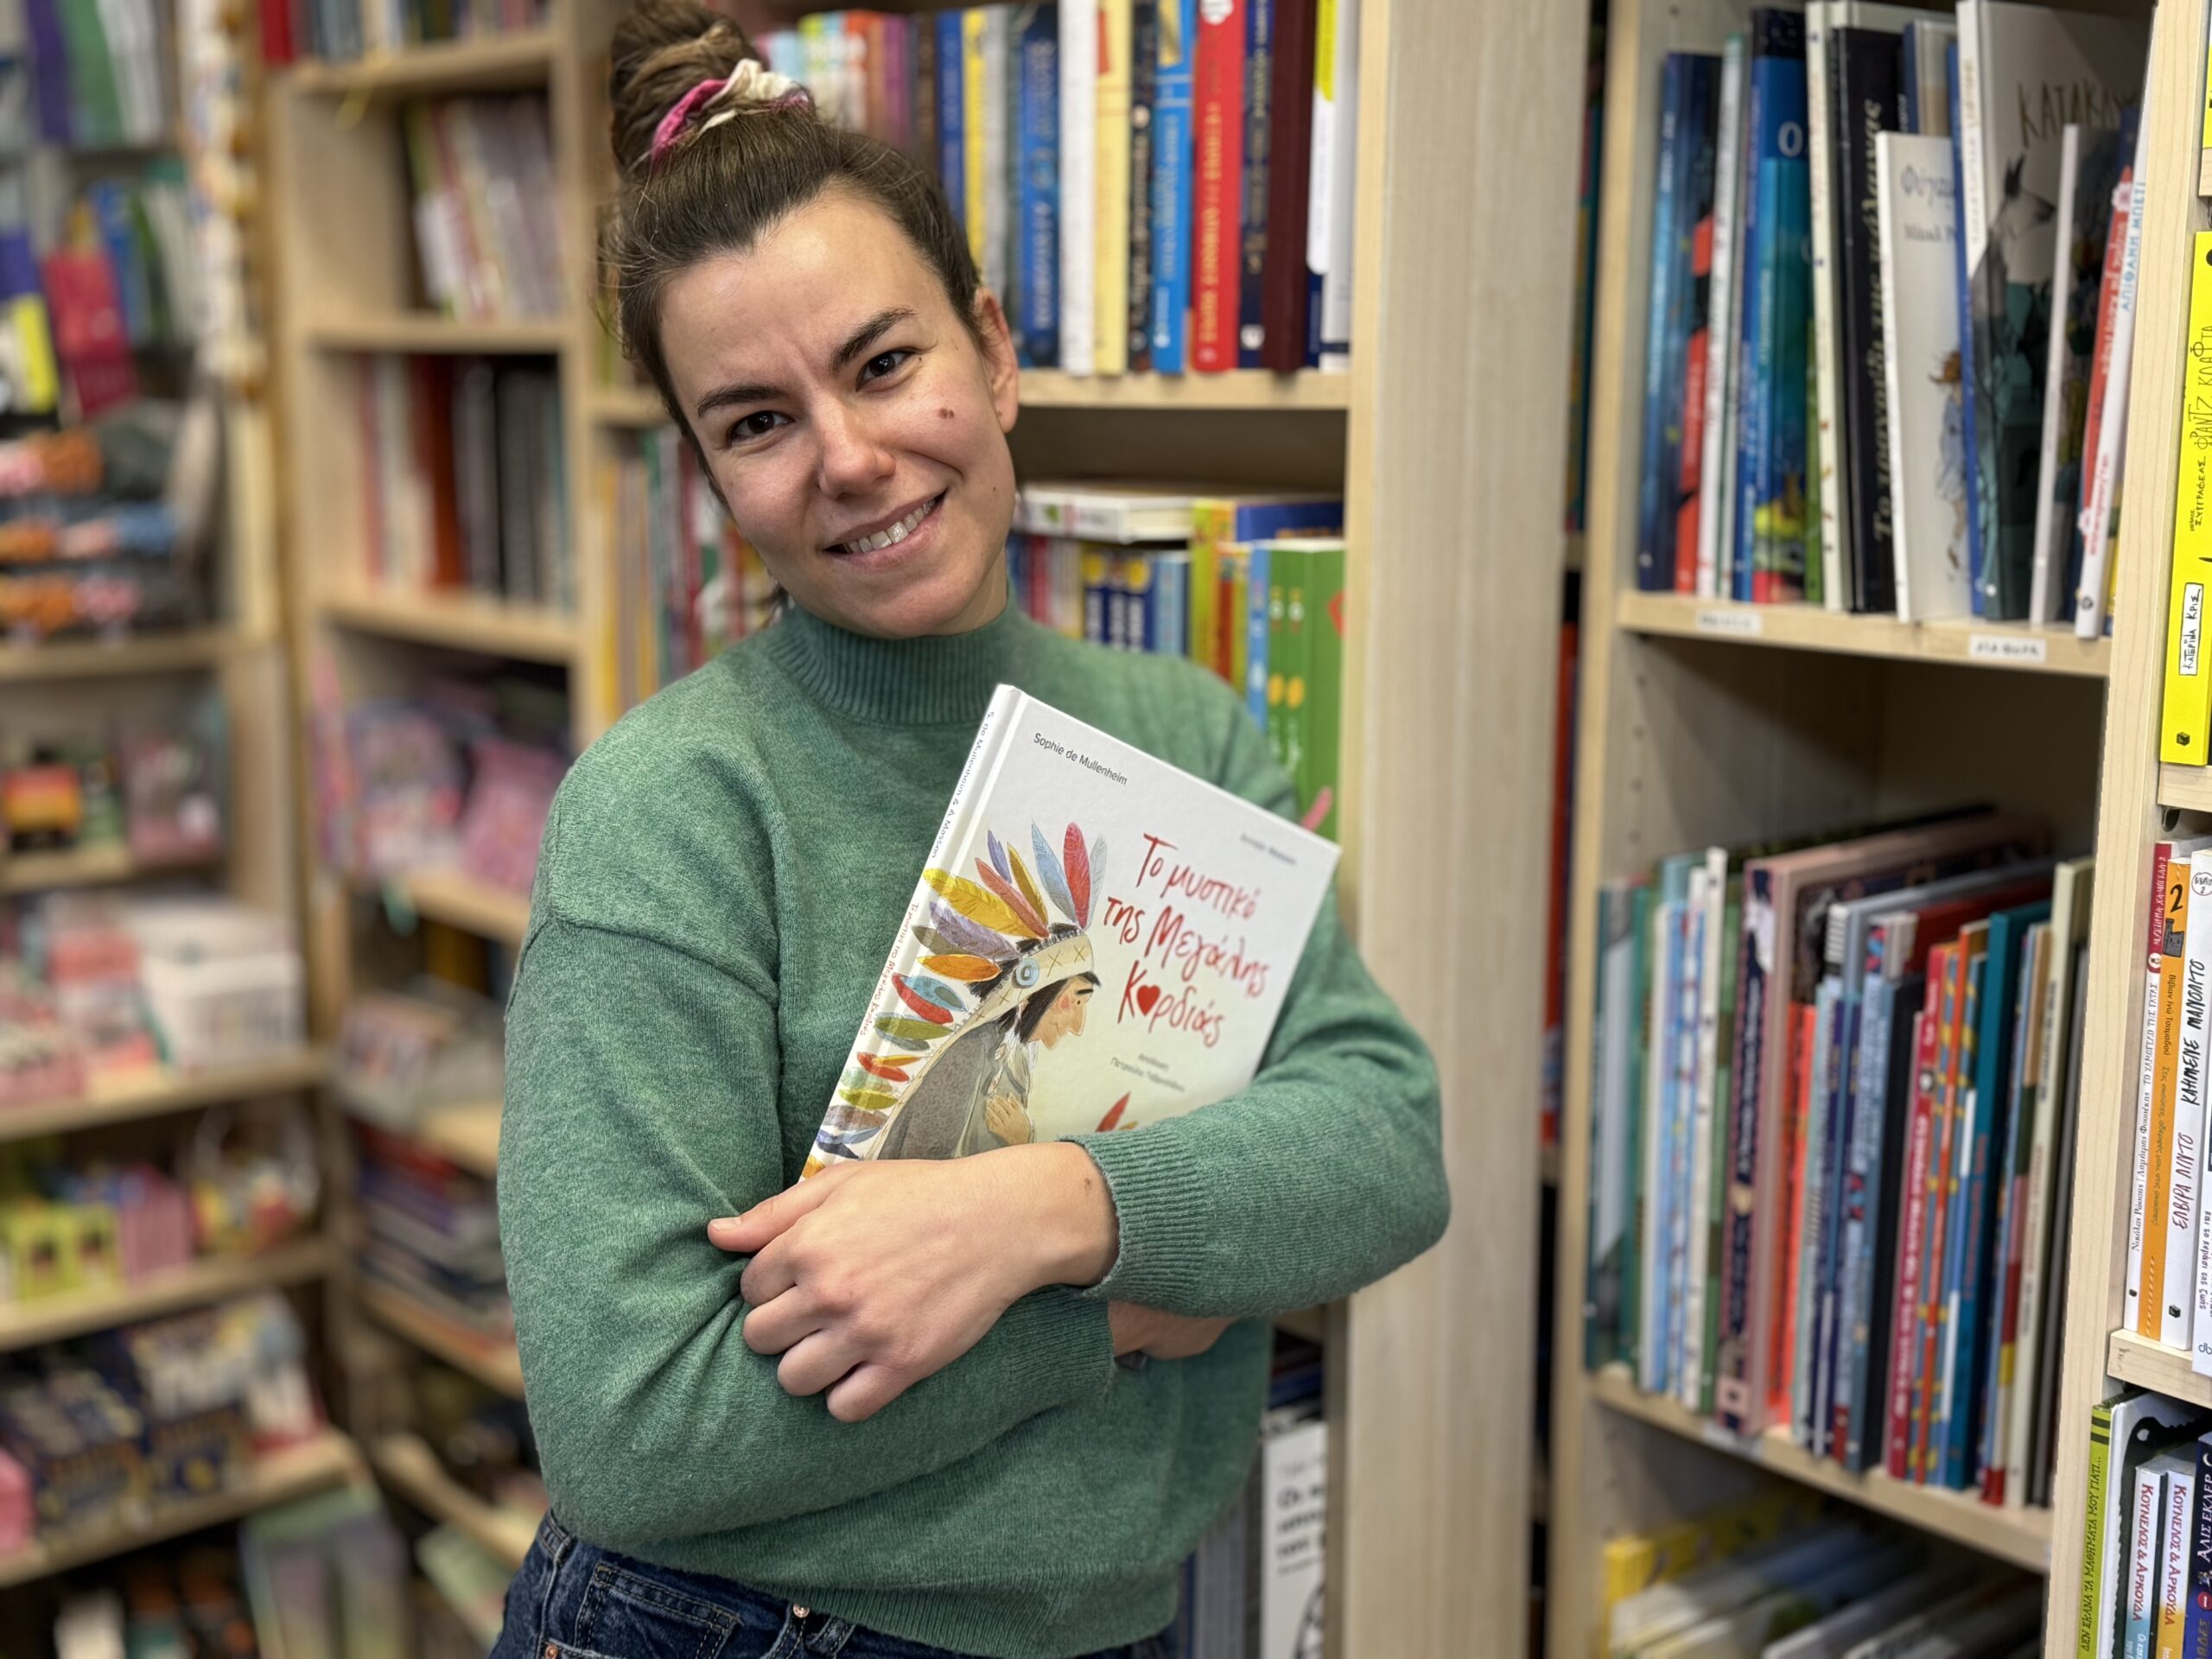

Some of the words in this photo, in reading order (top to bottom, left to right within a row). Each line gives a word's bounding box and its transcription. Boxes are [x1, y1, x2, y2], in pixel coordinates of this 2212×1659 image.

[2195, 456, 2206, 525] ΣΥΓΓΡΑΦΕΑΣ
[1033, 732, 1065, 755] Sophie
[1065, 749, 1078, 762] de
[1078, 754, 1128, 785] Mullenheim
[1136, 832, 1179, 888] Το
[1159, 865, 1262, 919] μυστικό
[2170, 883, 2183, 913] 2
[1103, 896, 1146, 944] της
[1144, 905, 1270, 998] Μεγάλης
[2167, 974, 2177, 999] Βίβιαν
[2187, 958, 2205, 1030] ΜΑΝΟΛΙΤΟ
[2180, 1036, 2199, 1106] ΚΑΗΜΕΝΕ
[2176, 1133, 2195, 1179] ΛΙΝΤΟ
[2171, 1183, 2195, 1230] ΕΛΒΙΡΑ
[2203, 1211, 2212, 1224] και
[2088, 1492, 2099, 1516] ΜΟΥ
[2137, 1483, 2154, 1548] ΚΟΥΝΕΛΟΣ
[2170, 1484, 2187, 1550] ΚΟΥΝΕΛΟΣ
[2084, 1518, 2098, 1579] ΜΑΘΗΜΑΤΑ
[2137, 1549, 2148, 1560] &
[2170, 1552, 2181, 1563] &
[2196, 1524, 2212, 1562] ΑΛΙΣ
[2084, 1580, 2094, 1592] ΤΑ
[2133, 1561, 2148, 1622] ΑΡΚΟΥΔΑ
[2164, 1565, 2182, 1625] ΑΡΚΟΥΔΑ
[2082, 1595, 2093, 1629] ΕΚΑΝΑ
[2081, 1631, 2090, 1652] ΔΕΝ
